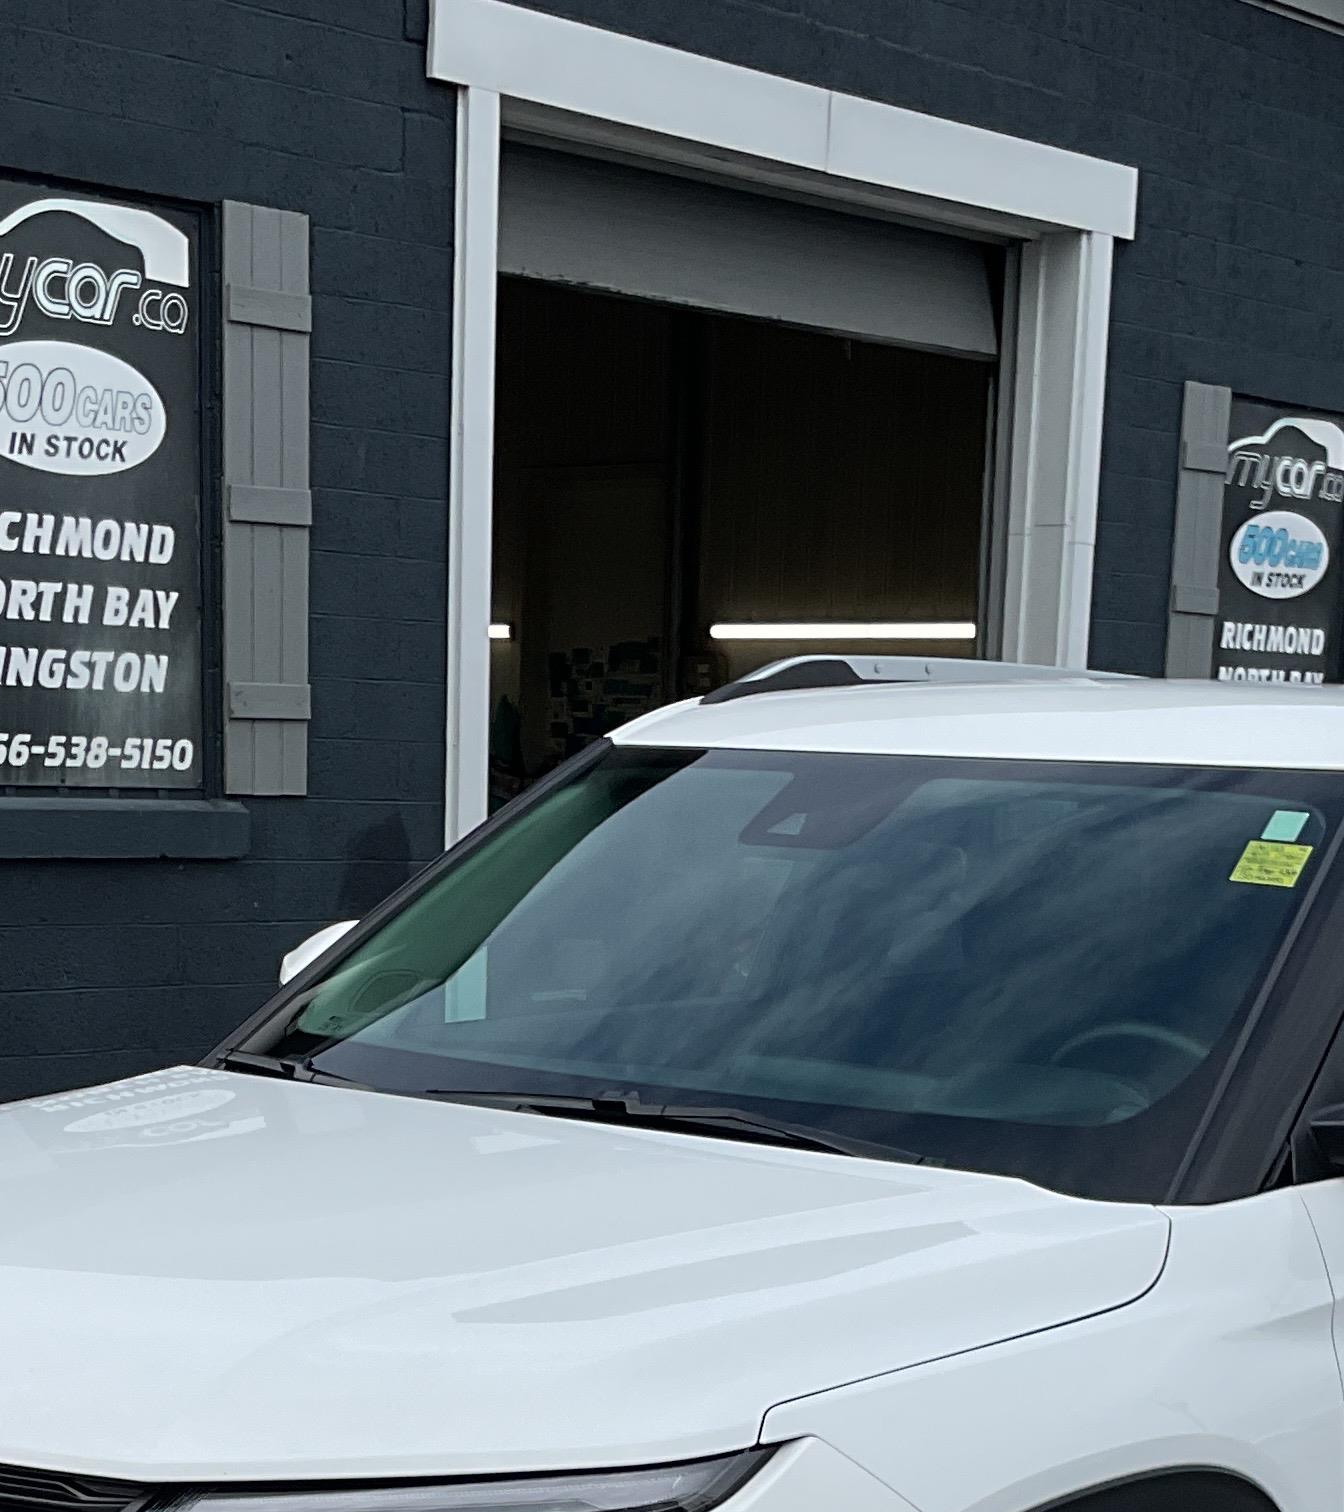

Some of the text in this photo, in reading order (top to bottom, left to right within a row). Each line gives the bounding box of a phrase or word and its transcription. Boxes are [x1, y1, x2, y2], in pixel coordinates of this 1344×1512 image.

[75, 386, 153, 435] CARS
[9, 431, 129, 462] IN STOCK
[1266, 572, 1306, 590] STOCK
[102, 586, 179, 629] BAY
[1219, 621, 1325, 655] RICHMOND
